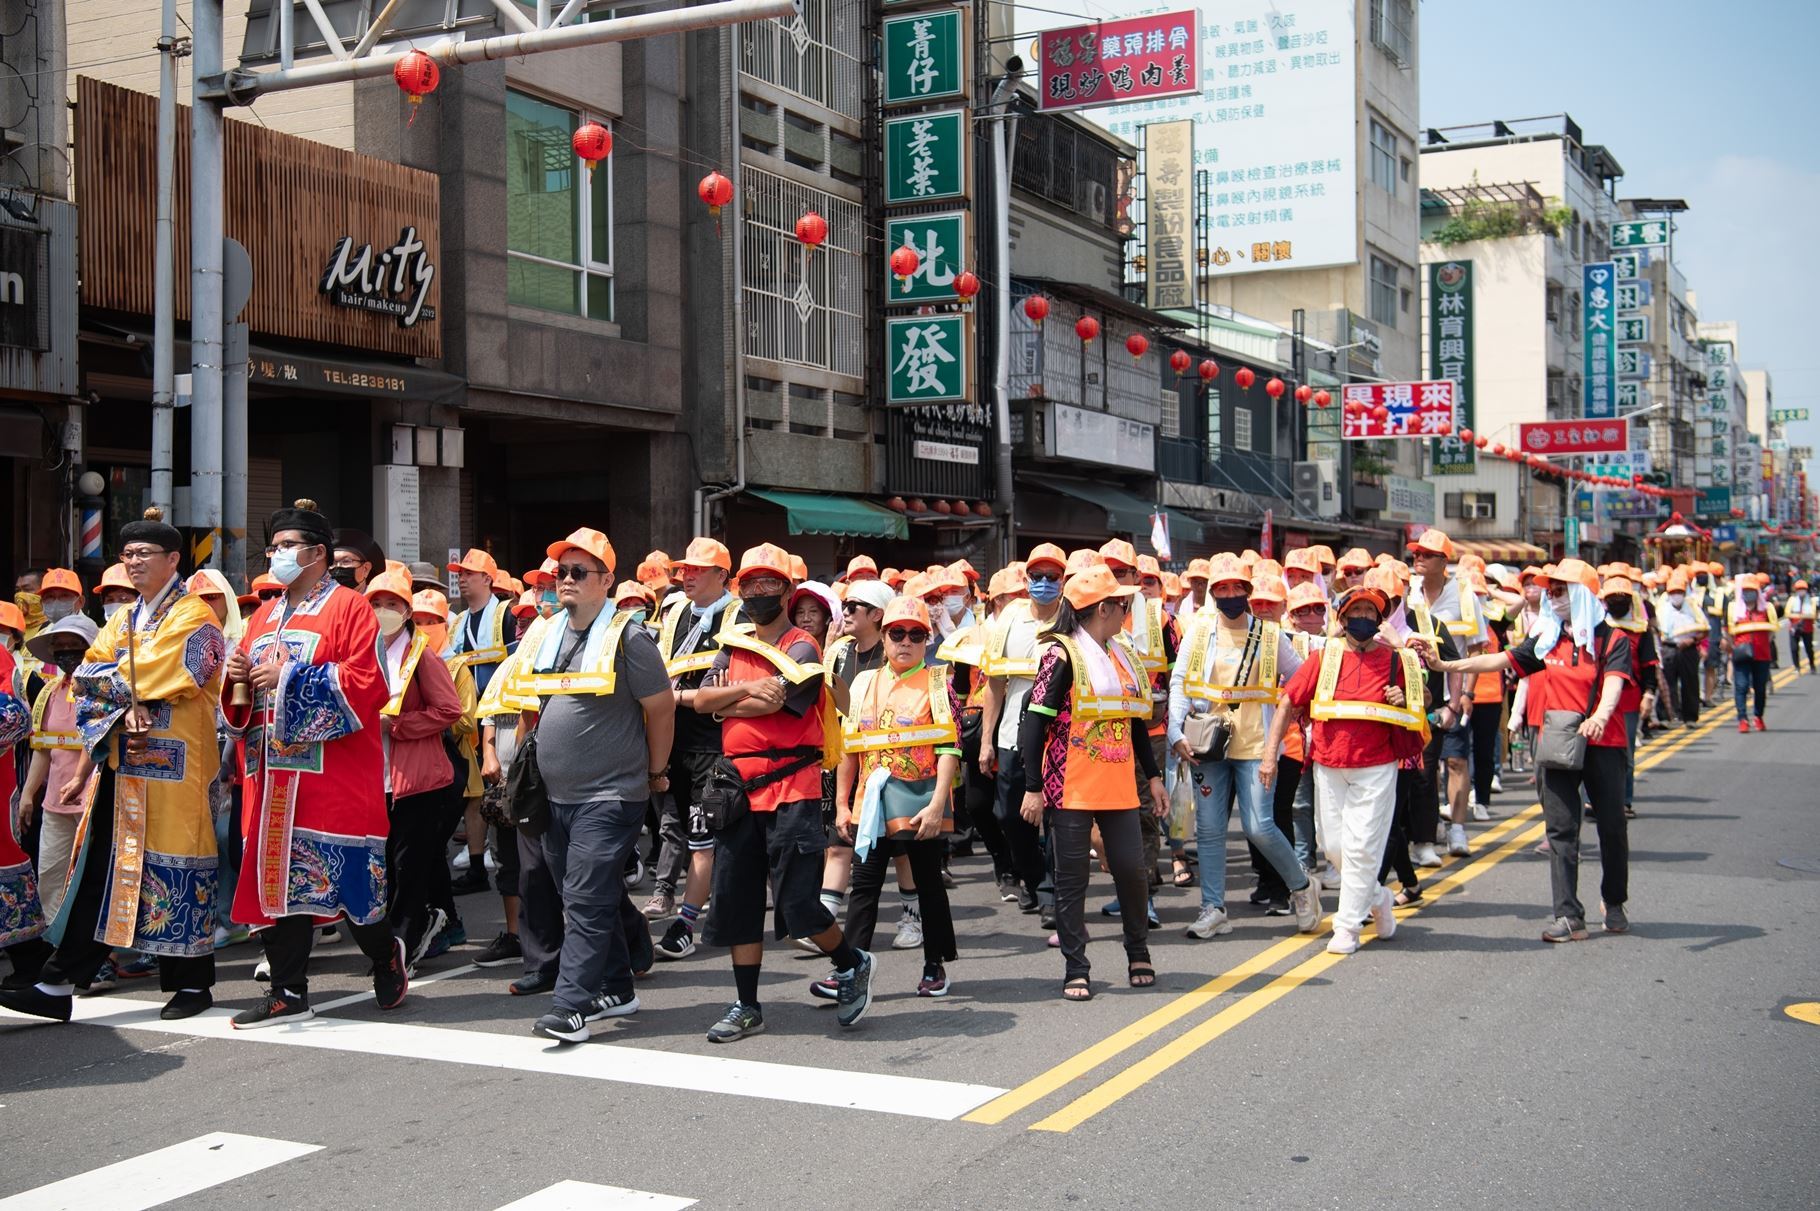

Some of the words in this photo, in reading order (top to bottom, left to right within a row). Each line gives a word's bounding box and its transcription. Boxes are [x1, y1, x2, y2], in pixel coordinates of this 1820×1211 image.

[906, 20, 939, 93] 菁仔
[1102, 27, 1189, 60] 藥頭排骨
[1049, 55, 1190, 99] 現炒鴨肉羹
[906, 120, 940, 195] 荖葉
[1614, 223, 1666, 245] 牙醫
[325, 227, 434, 326] Mity
[341, 291, 407, 315] hair/makeup
[324, 369, 405, 392] TEL:2238181
[893, 323, 956, 396] 發
